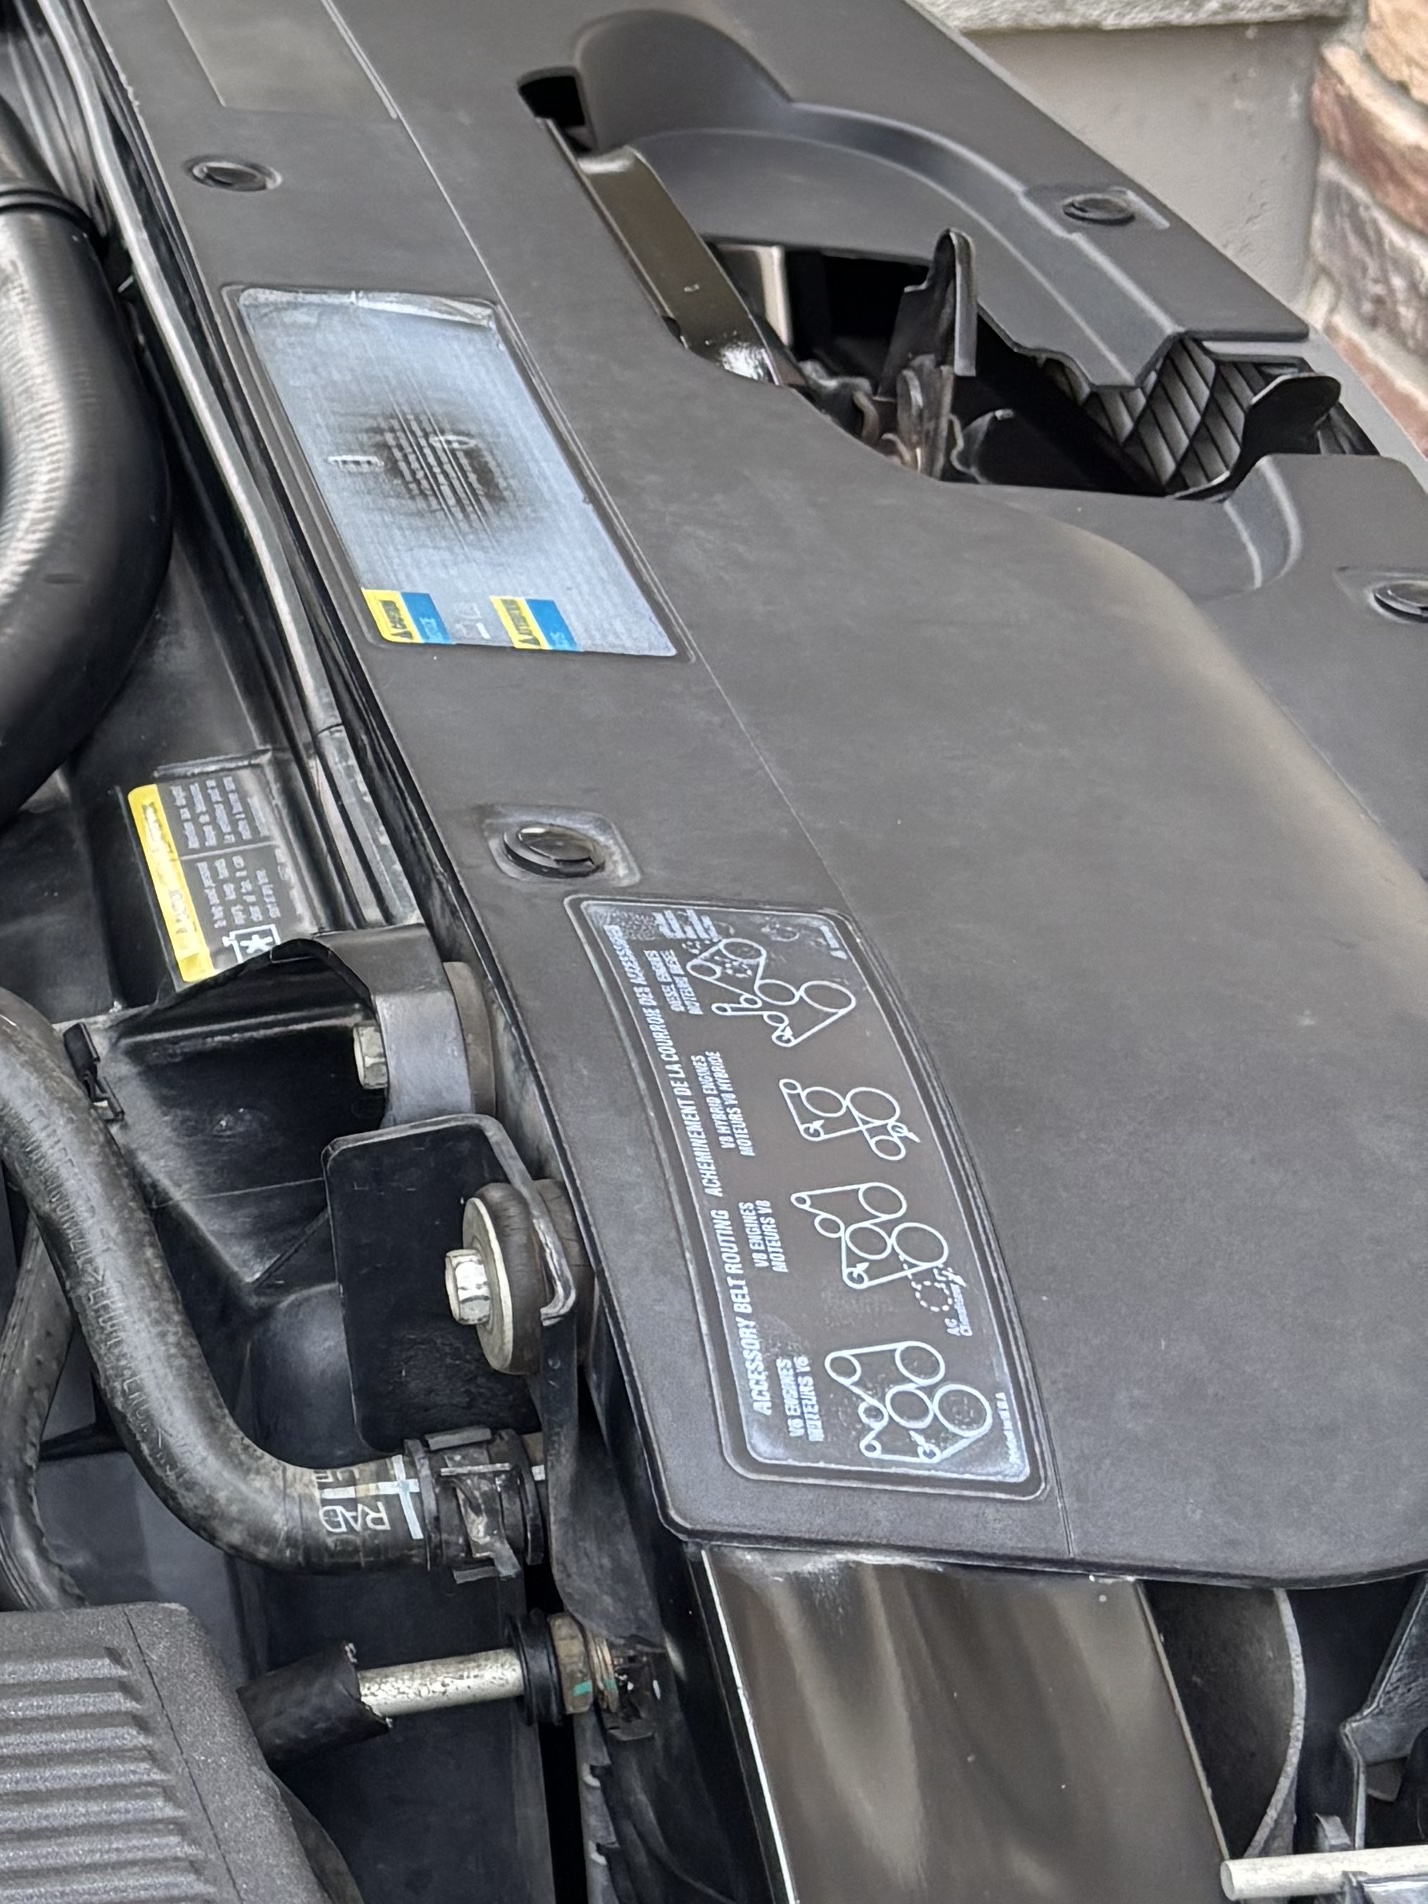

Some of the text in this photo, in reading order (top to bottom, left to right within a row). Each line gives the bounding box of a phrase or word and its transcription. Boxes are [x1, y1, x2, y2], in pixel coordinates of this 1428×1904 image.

[663, 1062, 685, 1077] LA
[669, 1079, 692, 1095] DE
[704, 1096, 731, 1133] HYBRID
[725, 1106, 755, 1156] MOTEURS
[676, 1097, 724, 1196] ACHEMINEMENT
[737, 1201, 770, 1267] V8 ENGINES
[754, 1199, 788, 1272] MOTEURS V8
[709, 1208, 774, 1415] ACCESSORY BELT ROUTING
[319, 1502, 391, 1533] RAD
